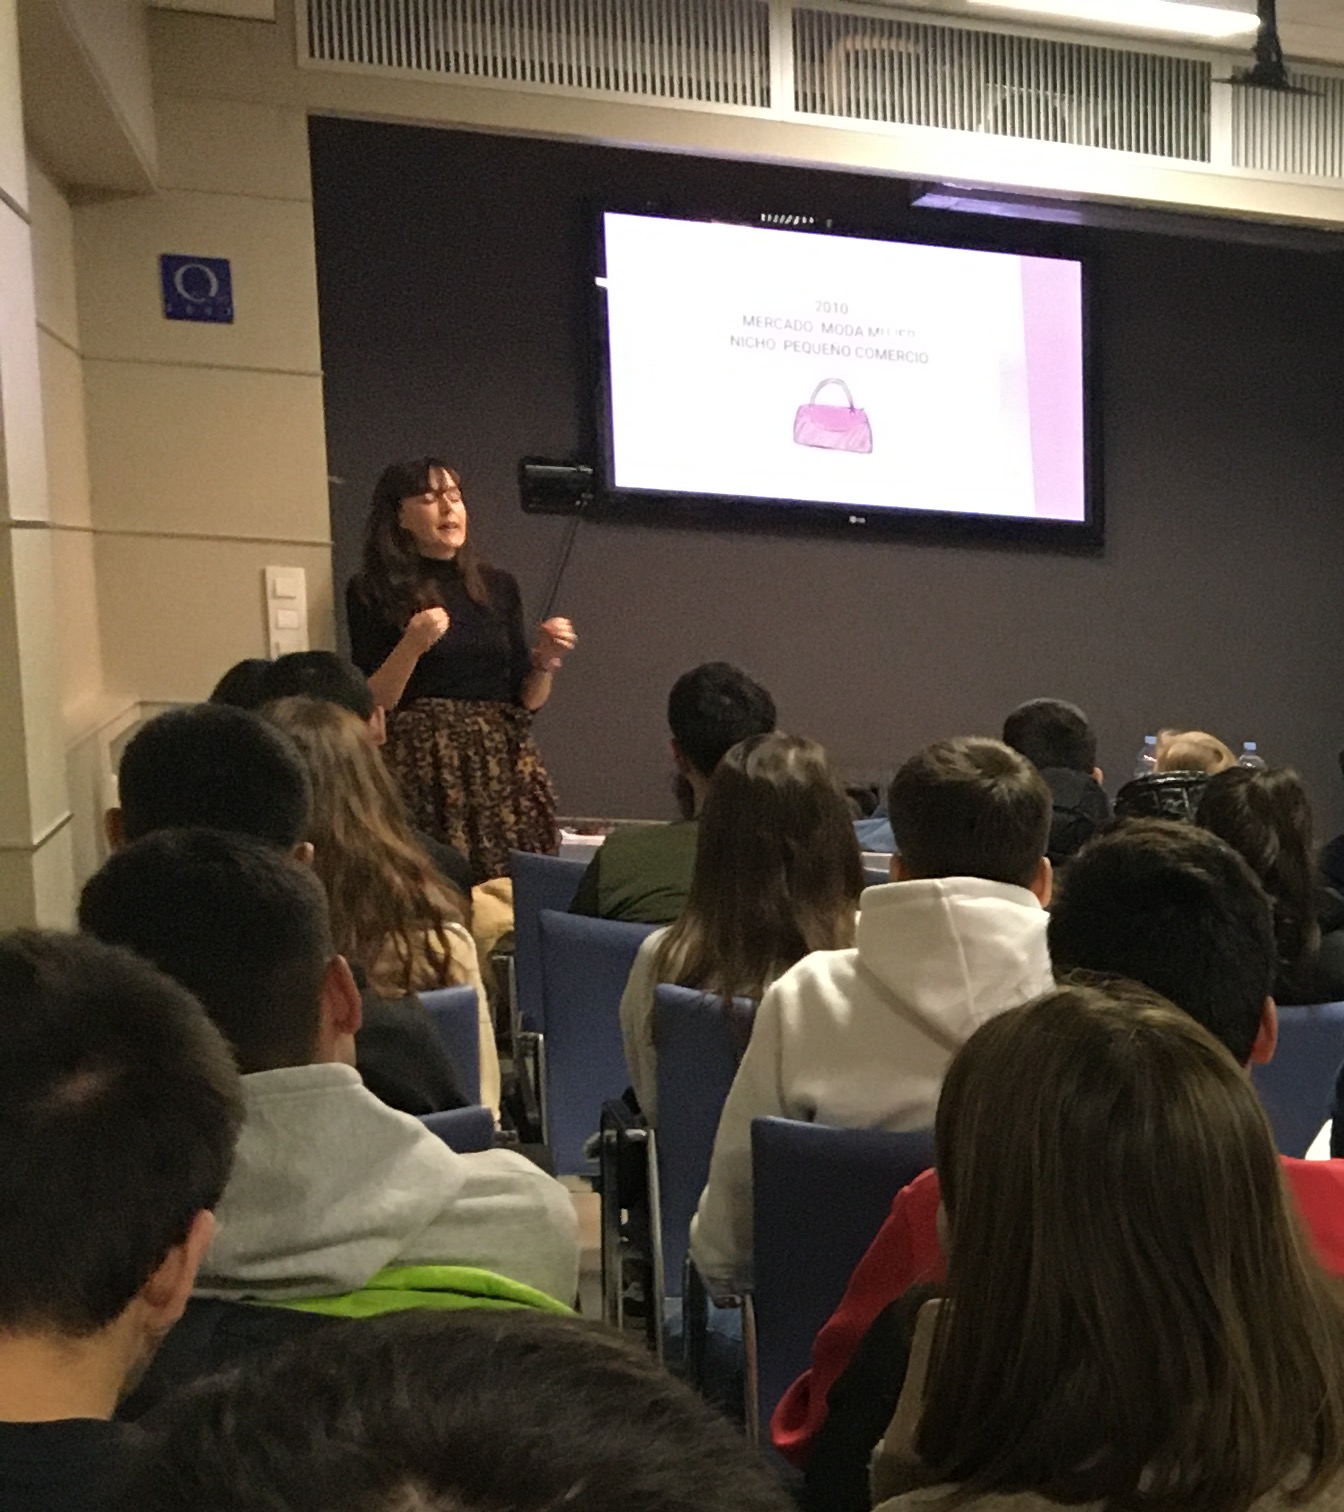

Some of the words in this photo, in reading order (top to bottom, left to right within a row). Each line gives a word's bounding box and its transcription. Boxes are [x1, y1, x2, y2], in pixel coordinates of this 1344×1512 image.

[814, 299, 849, 316] 2010
[820, 321, 865, 338] MODA
[854, 345, 929, 365] COMERCIO
